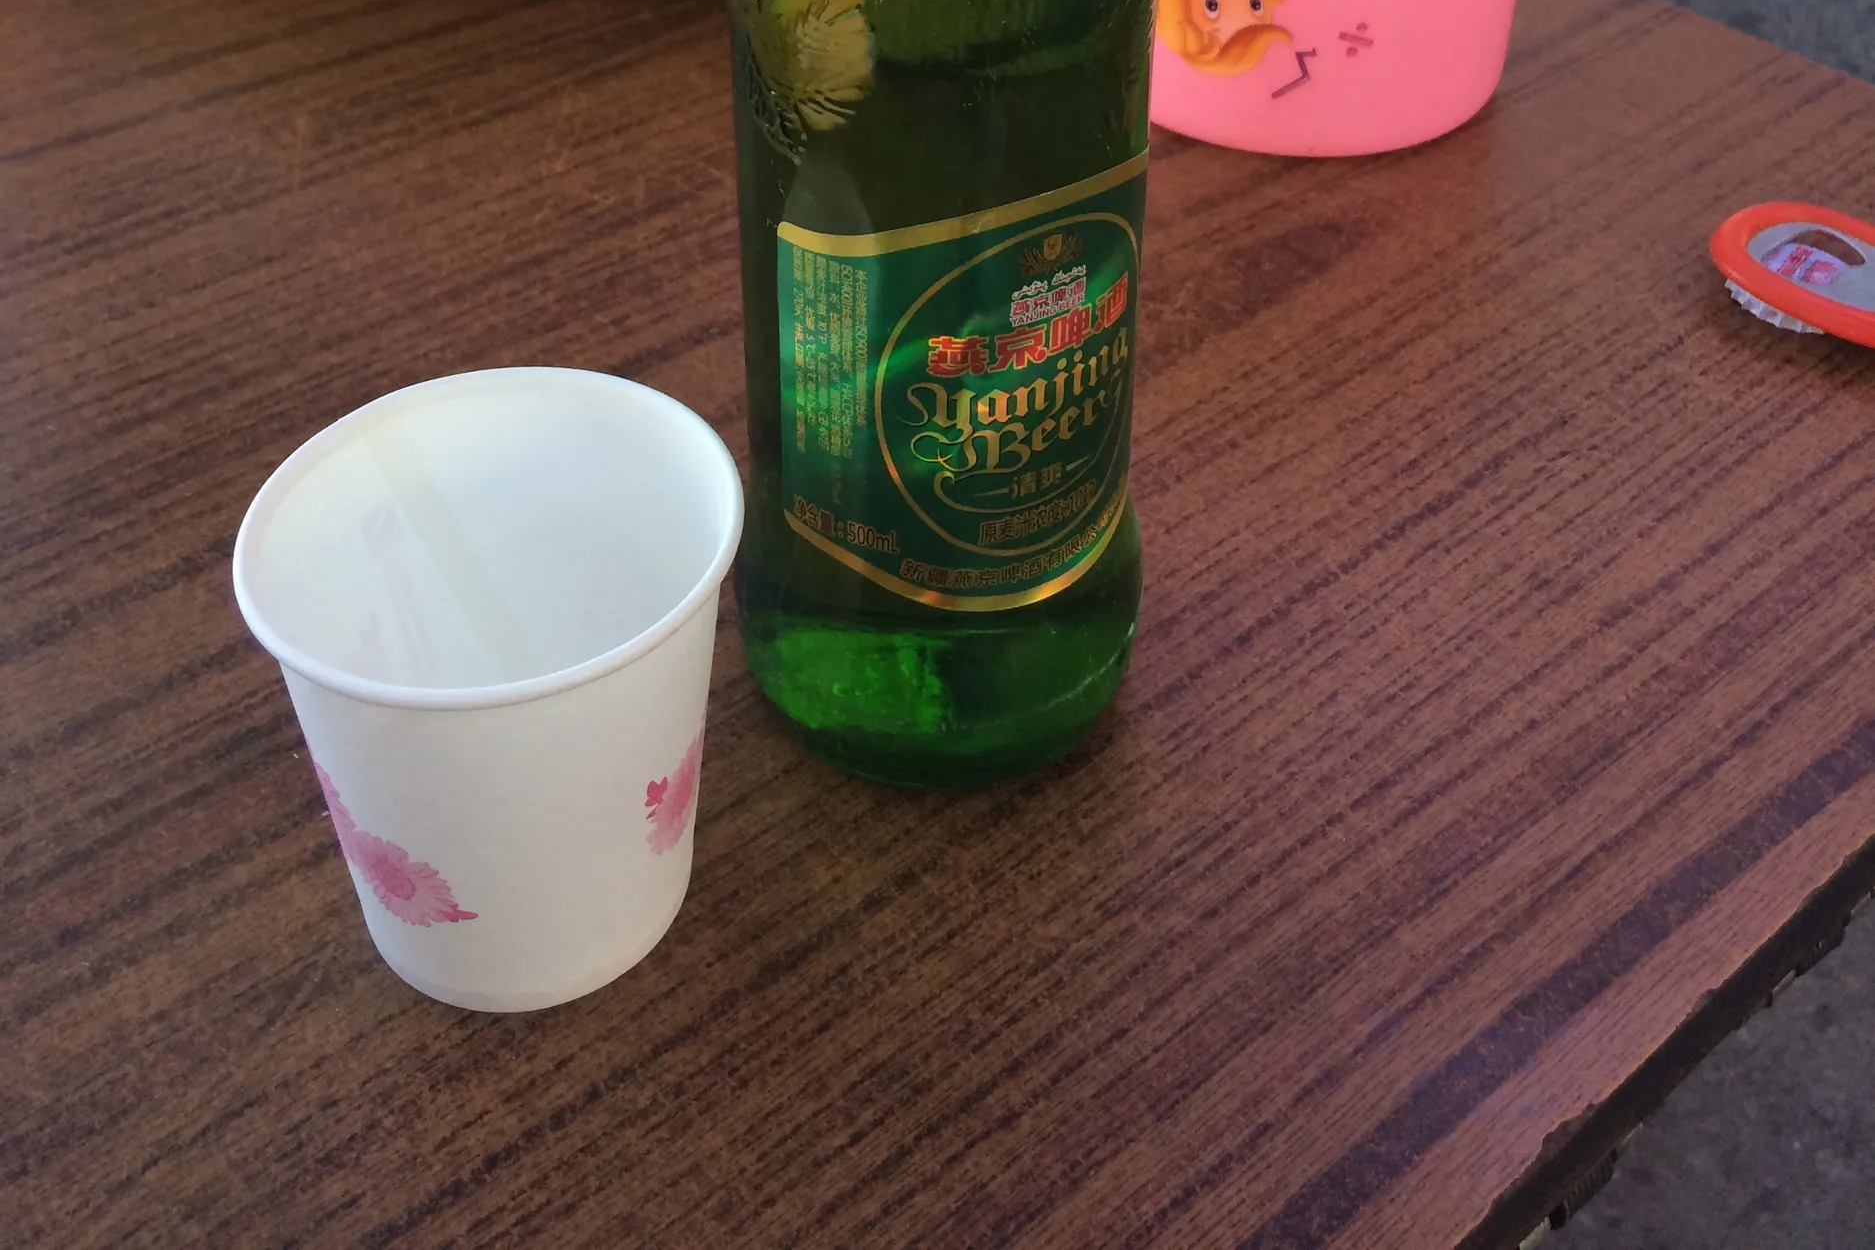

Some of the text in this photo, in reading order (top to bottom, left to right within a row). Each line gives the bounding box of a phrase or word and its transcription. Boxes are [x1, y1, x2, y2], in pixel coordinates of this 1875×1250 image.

[926, 270, 1130, 379] 燕京啤酒
[1011, 305, 1056, 326] YANJING
[910, 388, 1108, 485] Beer
